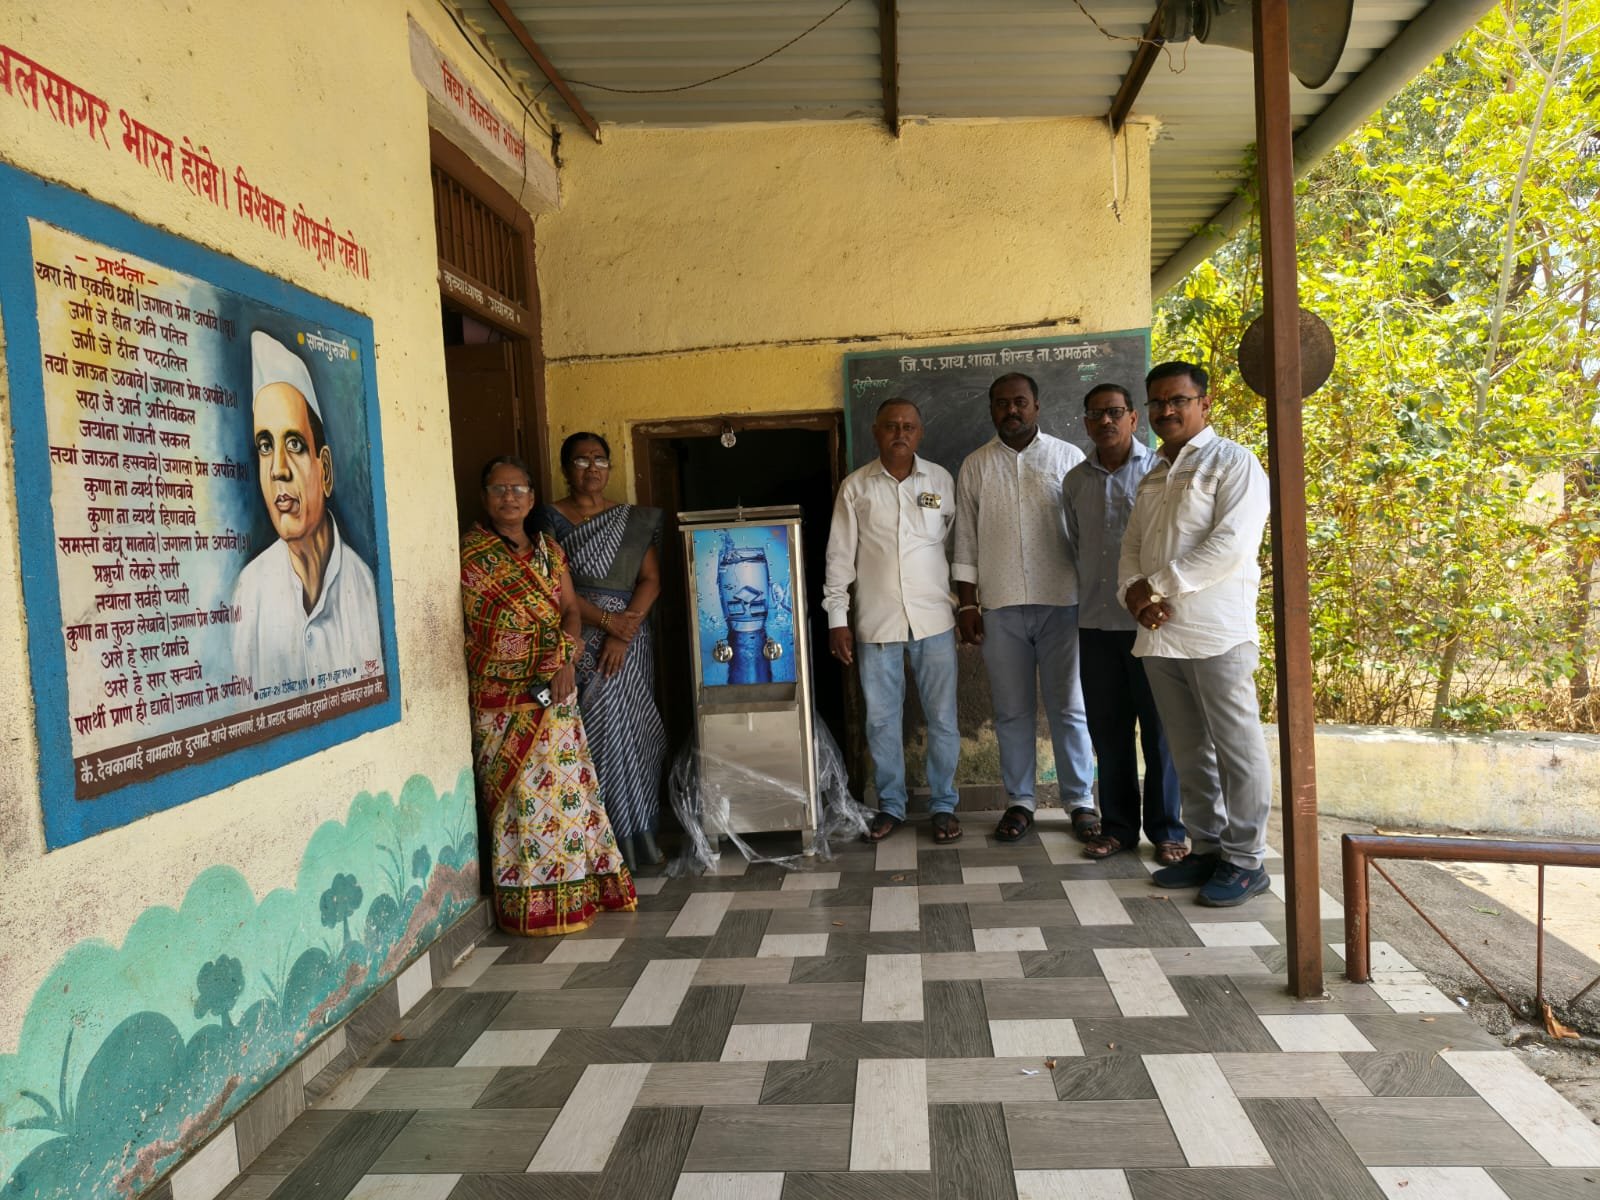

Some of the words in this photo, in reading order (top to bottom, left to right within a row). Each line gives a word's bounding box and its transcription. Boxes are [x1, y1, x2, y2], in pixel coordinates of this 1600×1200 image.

[120, 108, 174, 183] भारत
[234, 166, 286, 240] विश्वात
[95, 256, 145, 285] प्रार्थना
[35, 261, 61, 287] खरा
[64, 265, 77, 290] तो
[79, 275, 114, 301] एकचि
[141, 294, 173, 316] जगाला
[175, 300, 191, 323] प्रेम
[69, 299, 93, 321] जगी
[96, 302, 107, 325] जे
[111, 307, 131, 330] हीन
[135, 316, 156, 339] अति
[160, 323, 187, 347] पतित
[71, 328, 96, 350] जगी
[99, 333, 112, 355] जे
[116, 336, 139, 361] दीन
[144, 348, 187, 373] पददलित
[45, 353, 69, 375] तयां
[72, 360, 108, 382] जाऊन
[150, 376, 184, 398] जगाला
[187, 379, 201, 402] प्रेम
[76, 390, 99, 411] सदा
[103, 390, 114, 412] जे
[117, 393, 141, 417] आर्त
[79, 417, 118, 441] जयांना
[122, 421, 156, 448] गांजती
[159, 431, 191, 449] सकल
[50, 444, 79, 465] तयां
[82, 449, 119, 469] जाऊन
[162, 457, 193, 475] जगाला
[194, 456, 209, 477] प्रेम
[84, 477, 112, 502] कुणा
[114, 479, 128, 495] ना
[131, 474, 153, 499] व्यर्थ
[155, 477, 195, 500] शिणवावे
[87, 506, 114, 533] कुणा
[116, 508, 129, 524] ना
[132, 502, 155, 525] व्यर्थ
[159, 504, 197, 530] हिणवावे
[58, 536, 99, 557] समस्ता
[102, 531, 128, 560] बंधू
[160, 535, 192, 554] जगाला
[194, 531, 208, 551] प्रेम
[129, 557, 156, 580] लेकरे
[158, 555, 180, 580] सारी
[95, 592, 132, 613] तयाला
[134, 583, 161, 609] सर्वही
[164, 582, 189, 606] प्यारी
[66, 624, 92, 651] कुणा
[95, 623, 108, 640] ना
[111, 620, 134, 645] तुच्छ
[170, 612, 197, 632] जगाला
[196, 608, 208, 628] प्रेम
[101, 644, 123, 669] असे
[127, 643, 137, 666] हे
[140, 645, 160, 664] सार
[161, 635, 190, 658] धर्माचे
[104, 673, 128, 698] असे
[133, 670, 143, 696] हे
[146, 671, 166, 692] सार
[170, 660, 202, 684] सत्याचे
[74, 703, 106, 735] परार्थी
[135, 697, 148, 725] ही
[174, 689, 204, 709] जगाला
[205, 683, 219, 706] प्रेम
[145, 736, 182, 764] वामनशेठ
[211, 722, 227, 743] यांचे
